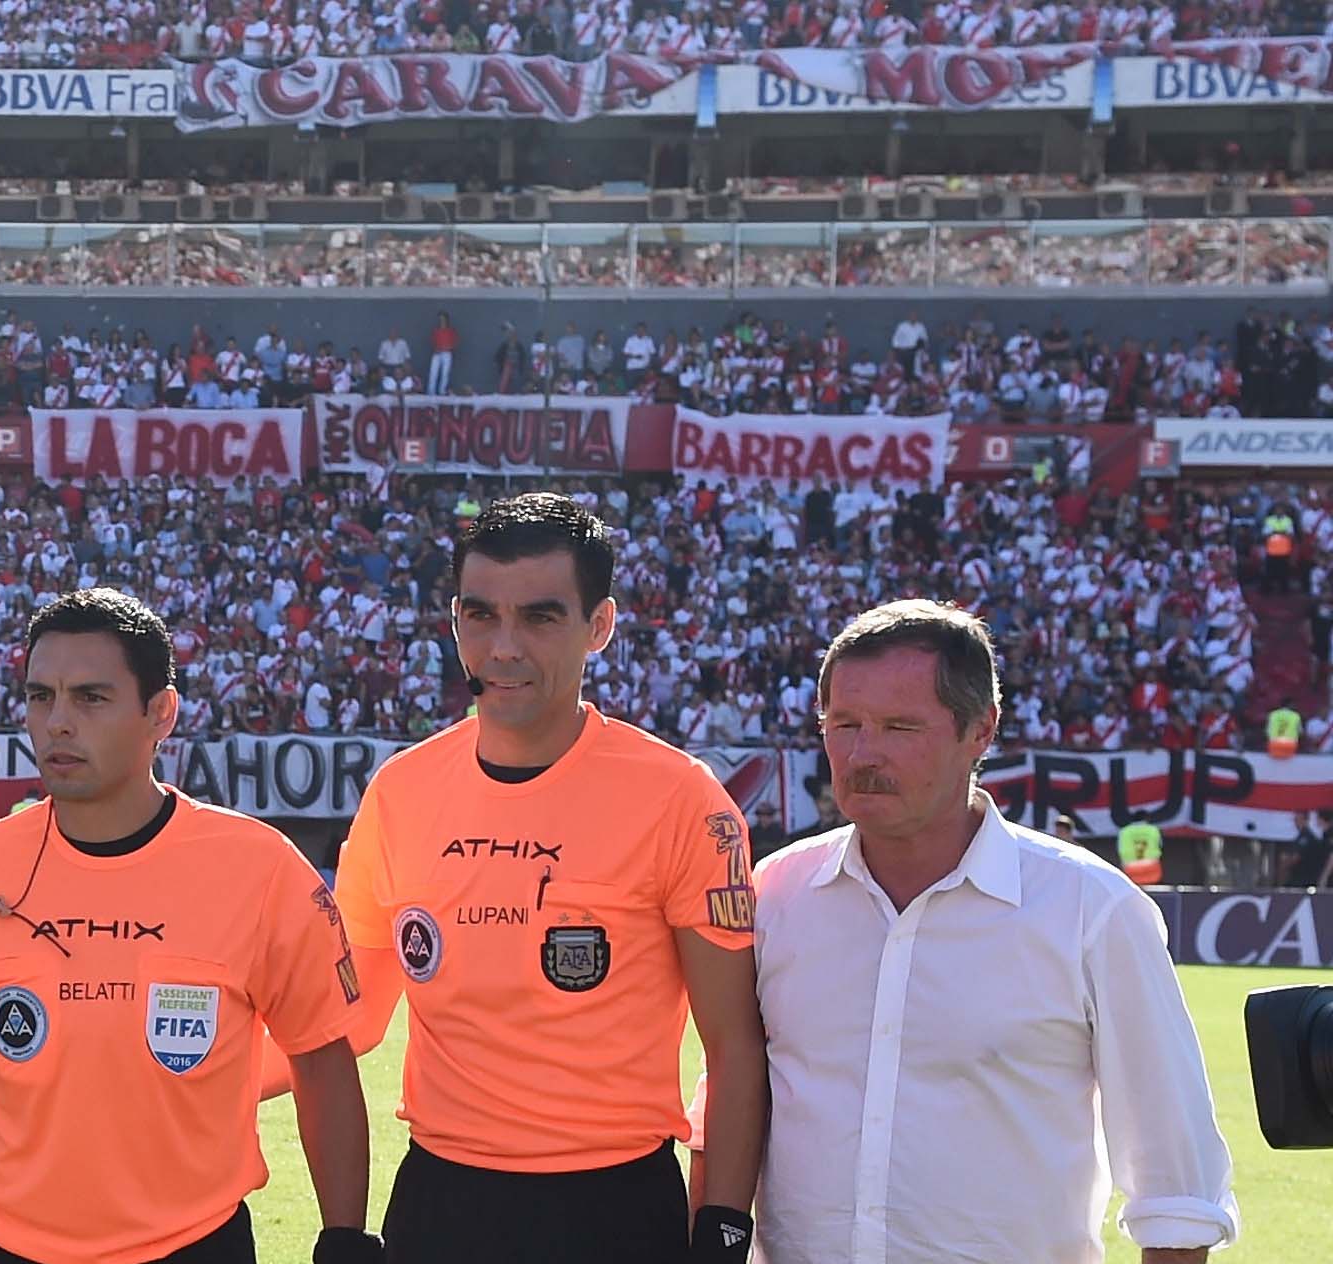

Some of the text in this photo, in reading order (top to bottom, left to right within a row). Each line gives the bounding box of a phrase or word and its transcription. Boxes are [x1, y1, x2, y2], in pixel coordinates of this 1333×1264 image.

[107, 76, 178, 112] Fra
[49, 416, 290, 479] LA BOCA
[404, 440, 421, 462] E
[675, 421, 934, 483] BARRACAS
[441, 838, 563, 862] ATHIX
[457, 906, 529, 926] LUPANI
[31, 918, 165, 941] ATHIX
[59, 982, 135, 1001] BELATTI
[155, 987, 214, 1000] ASSISTANT
[158, 999, 209, 1012] REFEREE
[154, 1016, 209, 1039] FIFA
[167, 1055, 193, 1067] 2016
